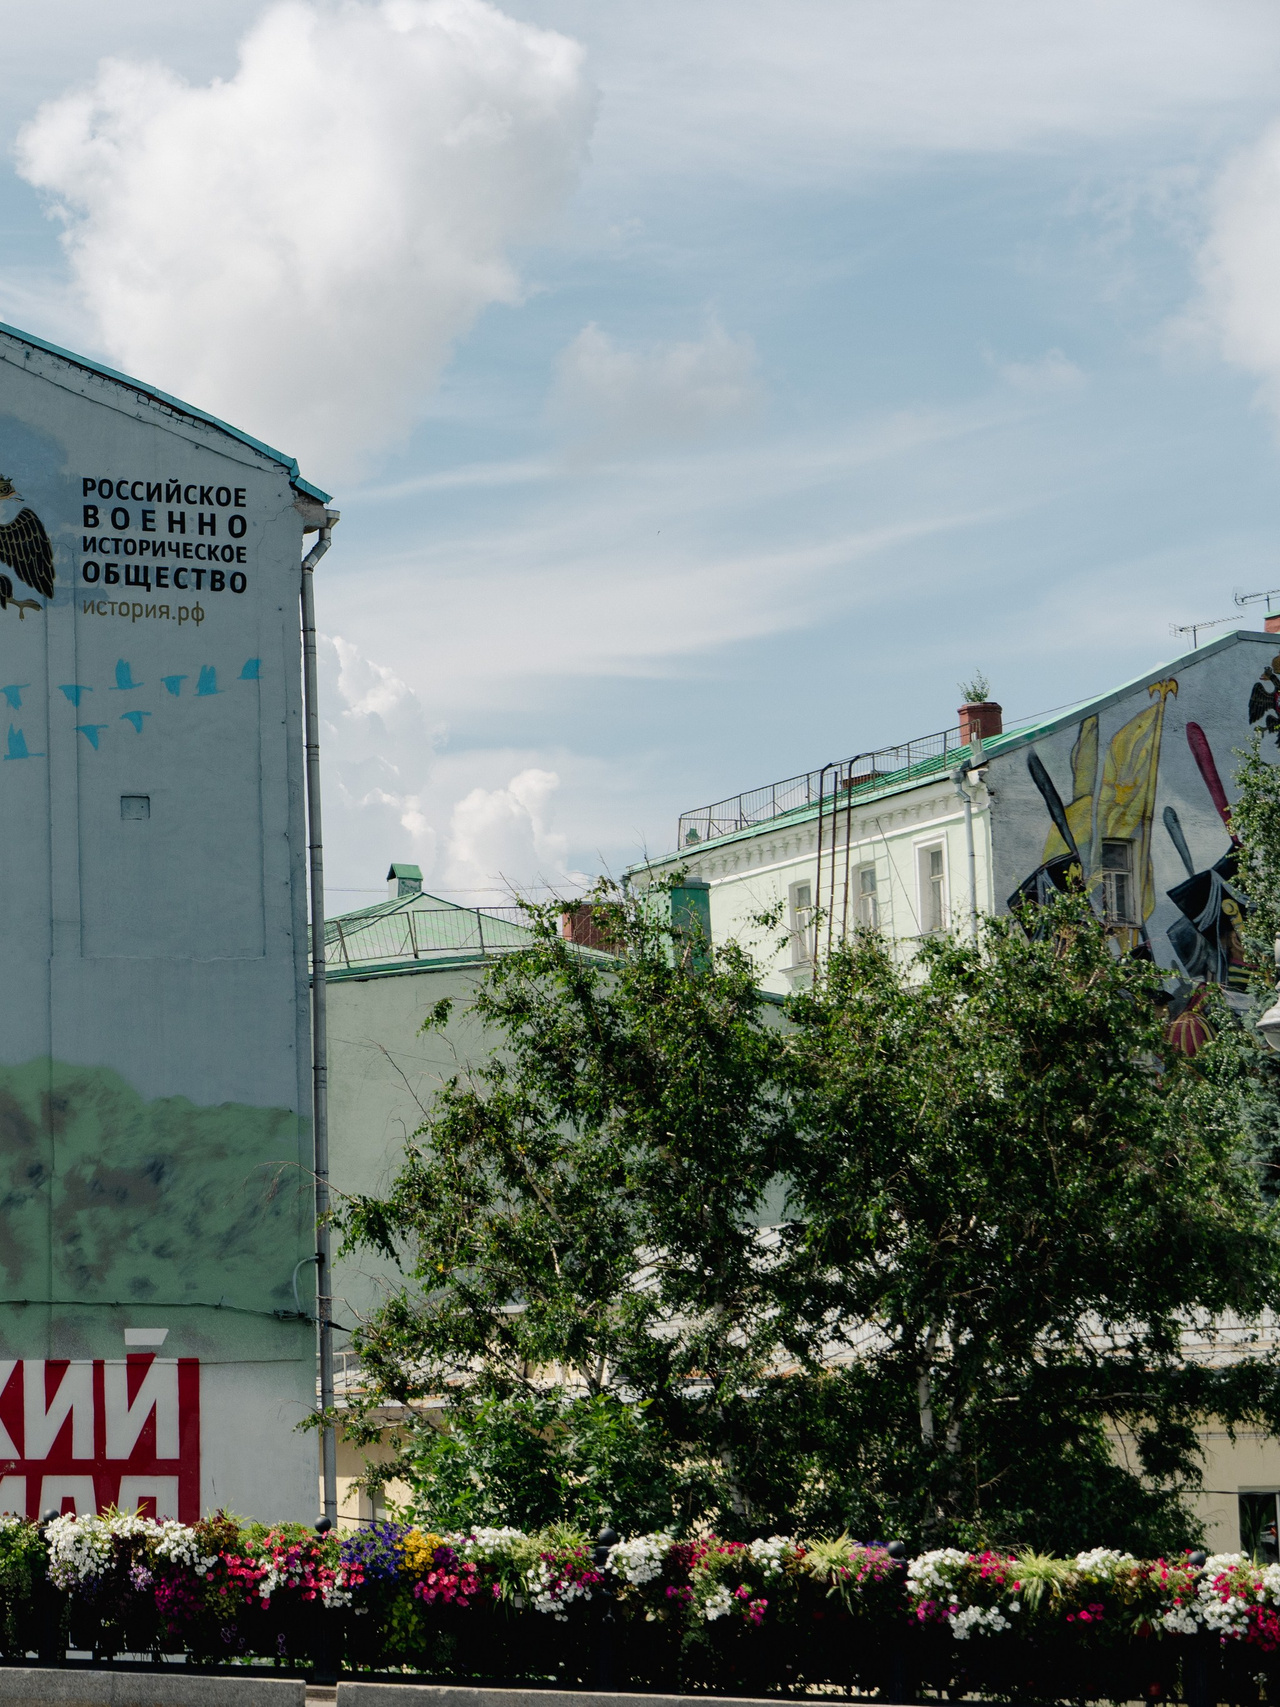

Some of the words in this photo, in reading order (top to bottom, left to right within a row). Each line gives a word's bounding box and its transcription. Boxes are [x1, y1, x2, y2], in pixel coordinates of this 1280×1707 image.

[82, 477, 247, 508] РОССИЙСКОЕ
[82, 504, 248, 539] ВОЕННО
[82, 535, 247, 564] ИСТОРИЧЕСКОЕ
[82, 560, 248, 594] ОБЩЕСТВО
[82, 599, 205, 627] история.рф
